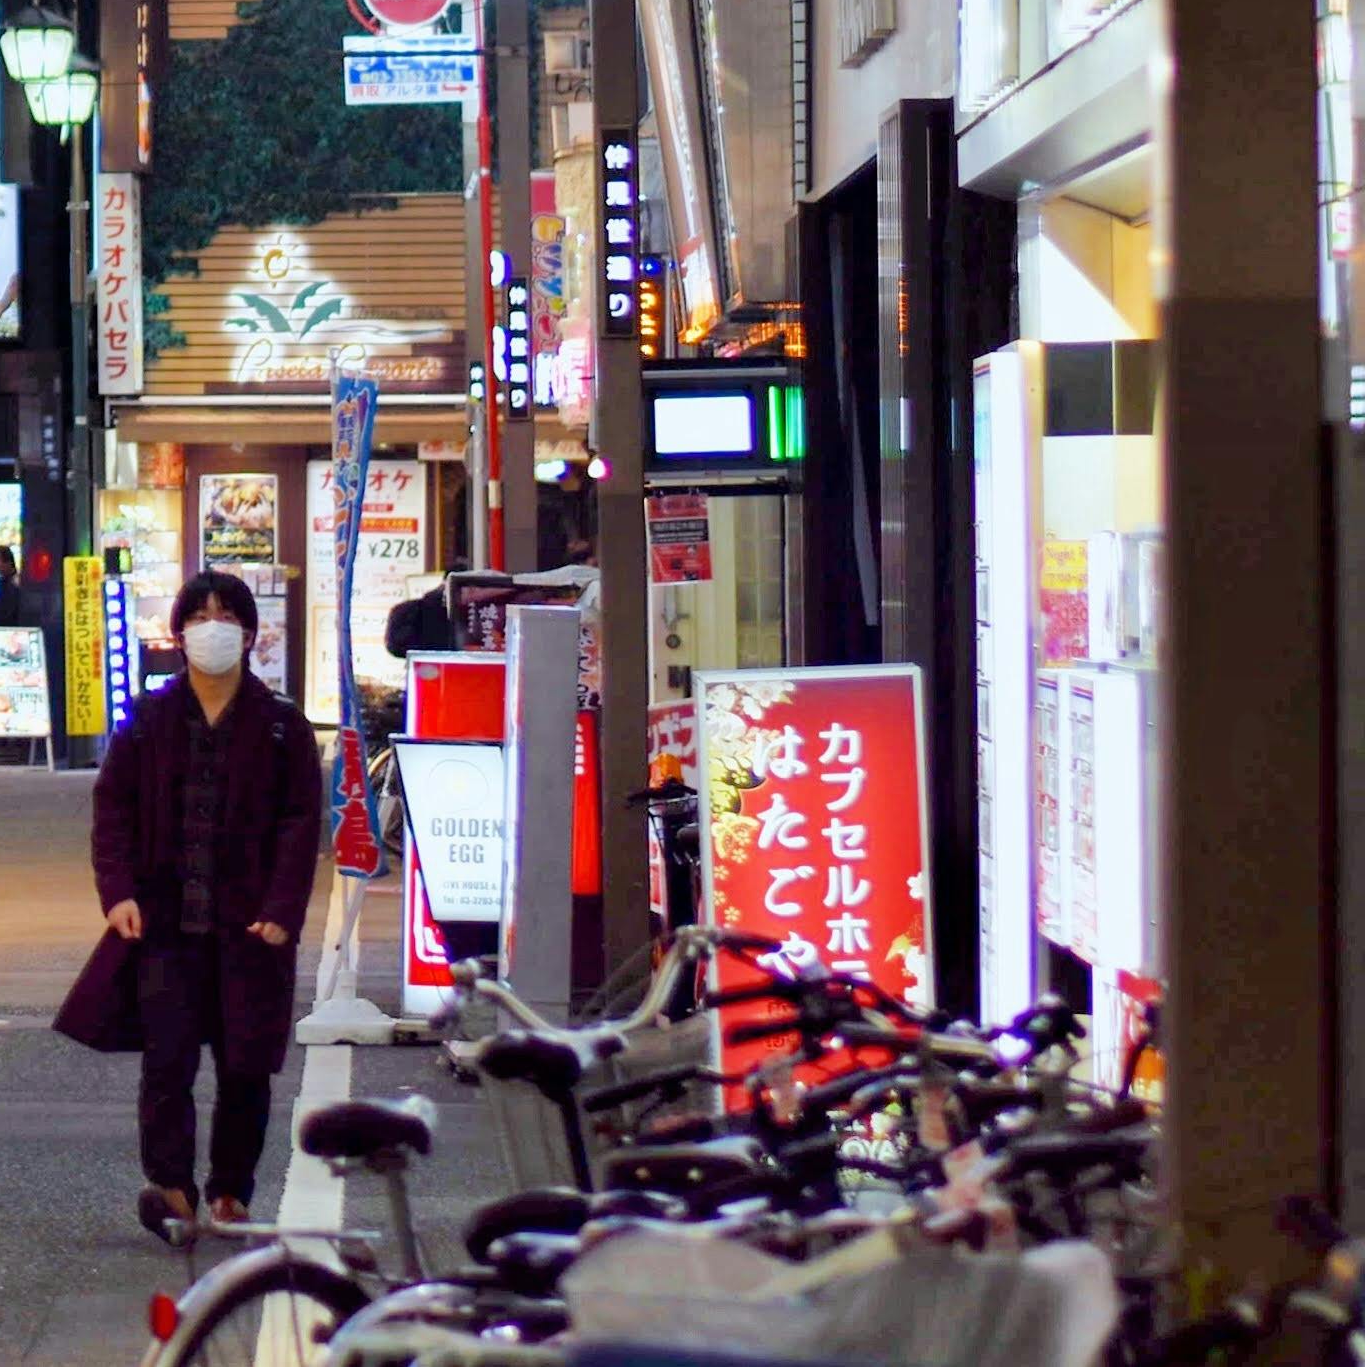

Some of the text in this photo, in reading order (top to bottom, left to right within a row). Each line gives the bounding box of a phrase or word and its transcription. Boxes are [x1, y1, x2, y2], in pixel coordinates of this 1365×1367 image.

[102, 186, 129, 382] カラオケパセラ
[368, 538, 420, 560] ¥278
[448, 843, 485, 864] EGG
